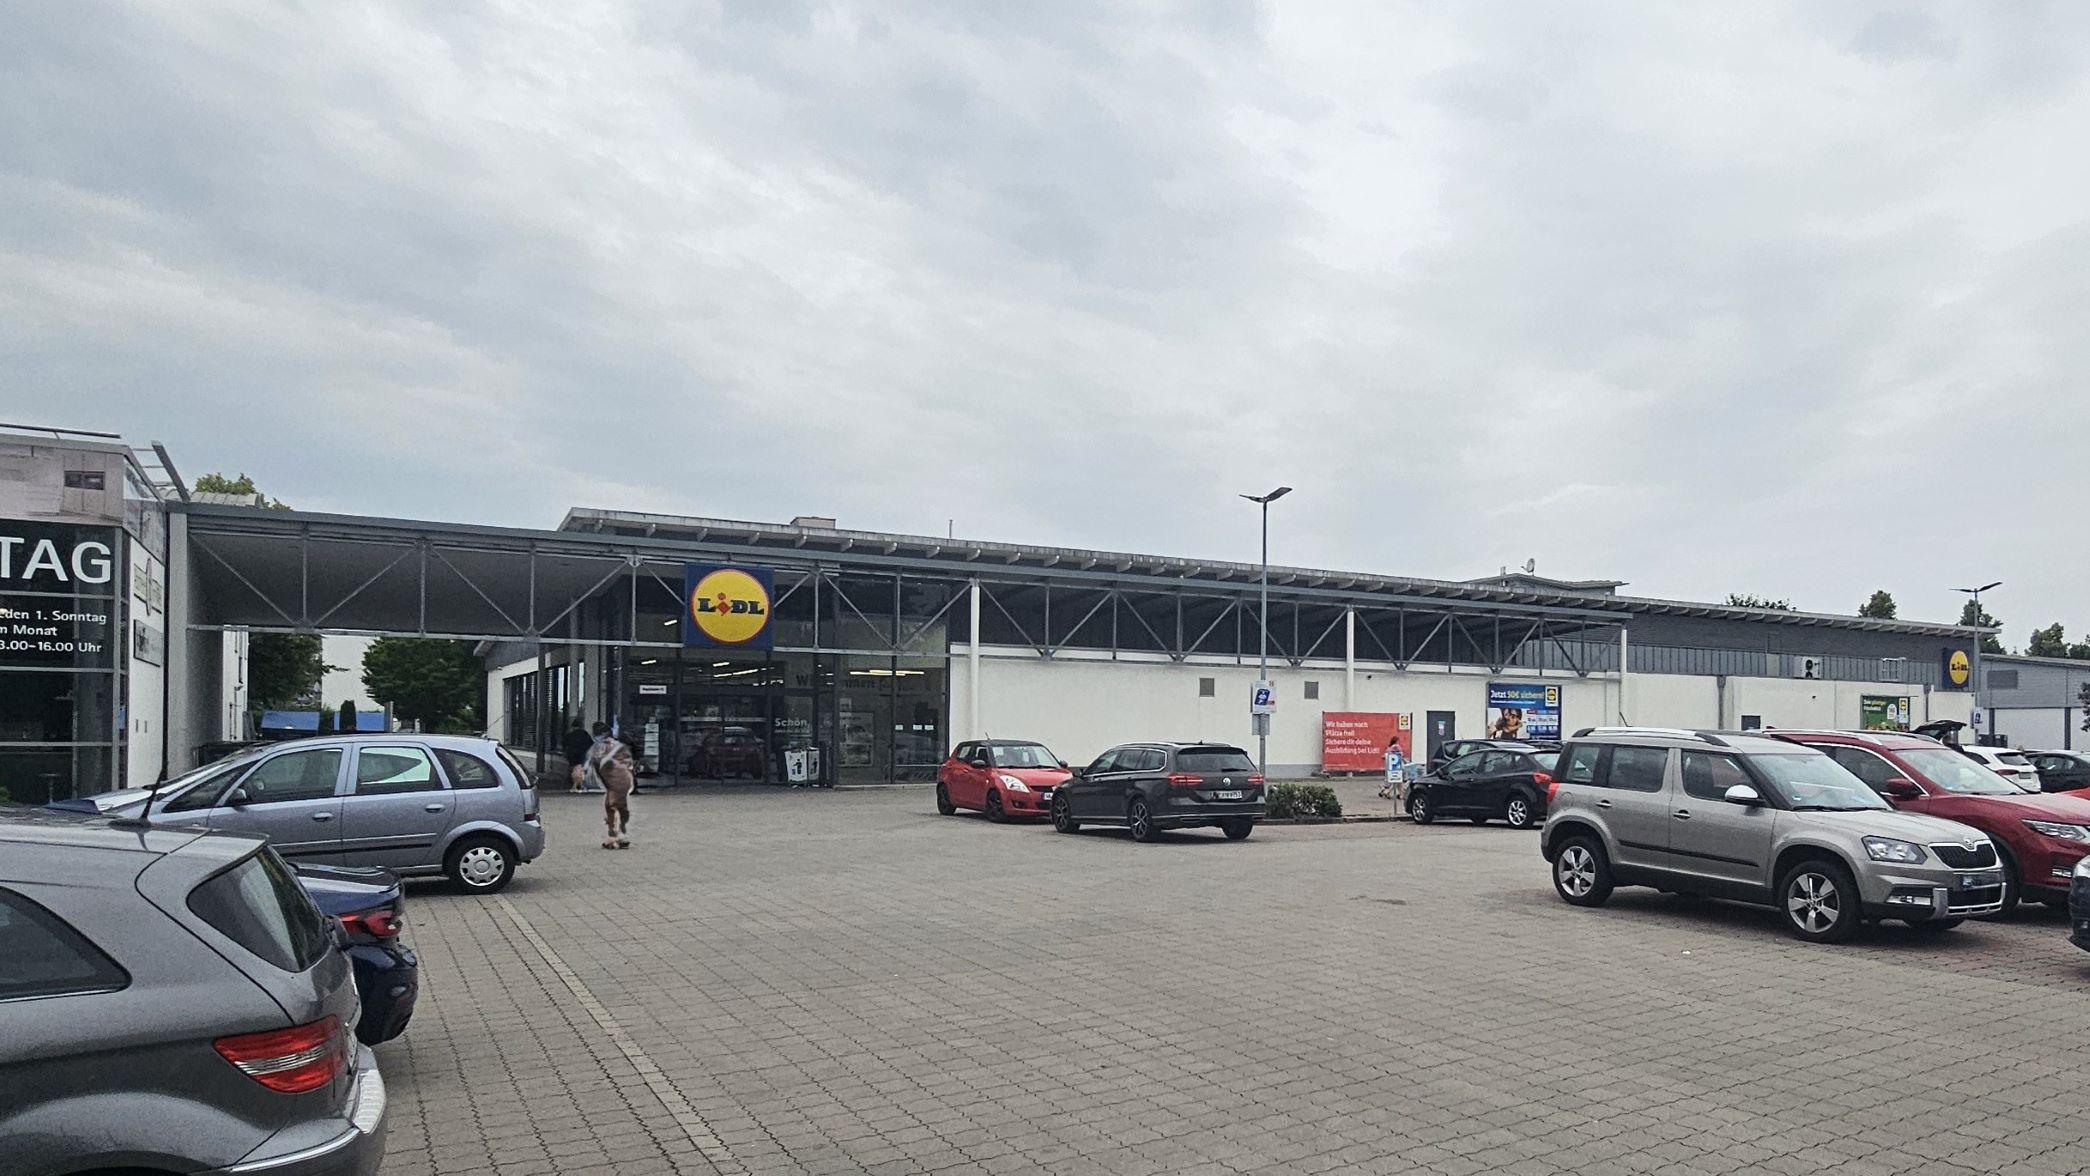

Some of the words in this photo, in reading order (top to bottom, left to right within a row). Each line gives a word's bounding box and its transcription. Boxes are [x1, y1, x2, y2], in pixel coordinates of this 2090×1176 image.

[0, 536, 111, 584] TAG
[36, 610, 48, 621] 1.
[52, 610, 107, 626] Sonntag
[13, 624, 58, 637] Monat
[78, 642, 102, 652] Uhr
